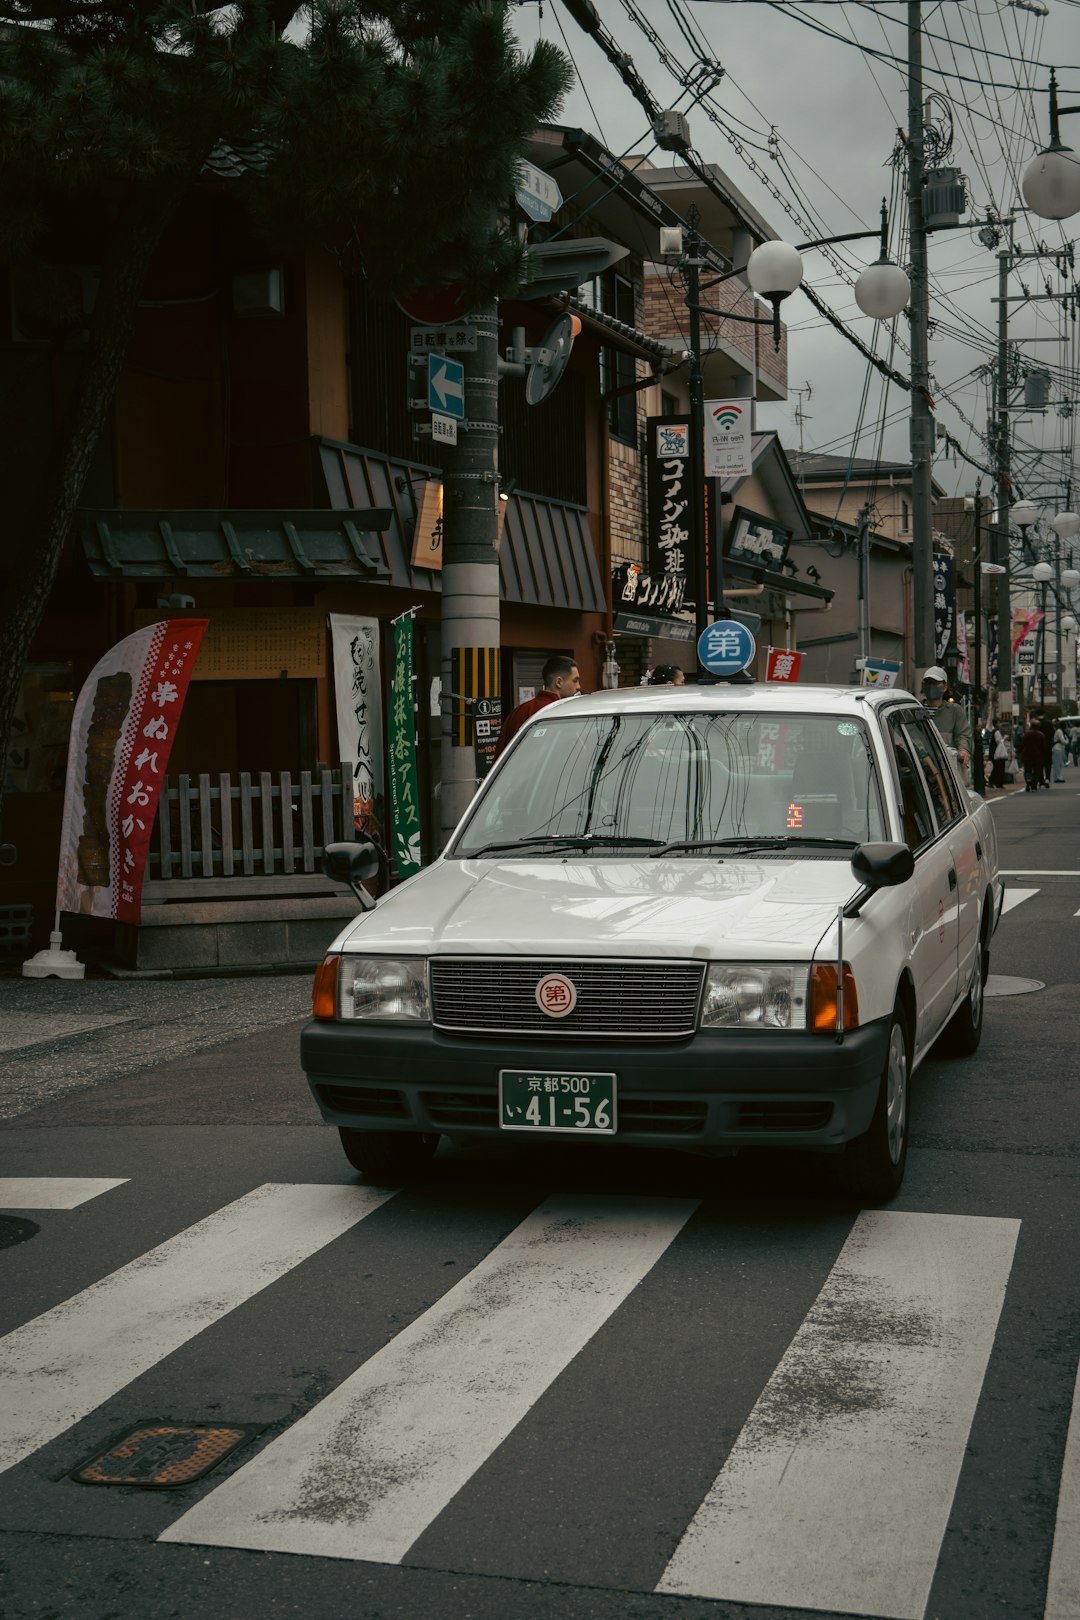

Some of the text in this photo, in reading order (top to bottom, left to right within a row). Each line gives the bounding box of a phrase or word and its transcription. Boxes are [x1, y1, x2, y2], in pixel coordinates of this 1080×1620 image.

[413, 332, 474, 346] 自転車を除く
[159, 643, 179, 678] もちもち
[172, 640, 193, 676] あったか
[707, 629, 742, 666] 第一
[389, 743, 397, 776] Special
[122, 680, 179, 874] 串ぬれおかき
[545, 985, 567, 1007] 第一
[505, 1095, 610, 1129] い 41-56
